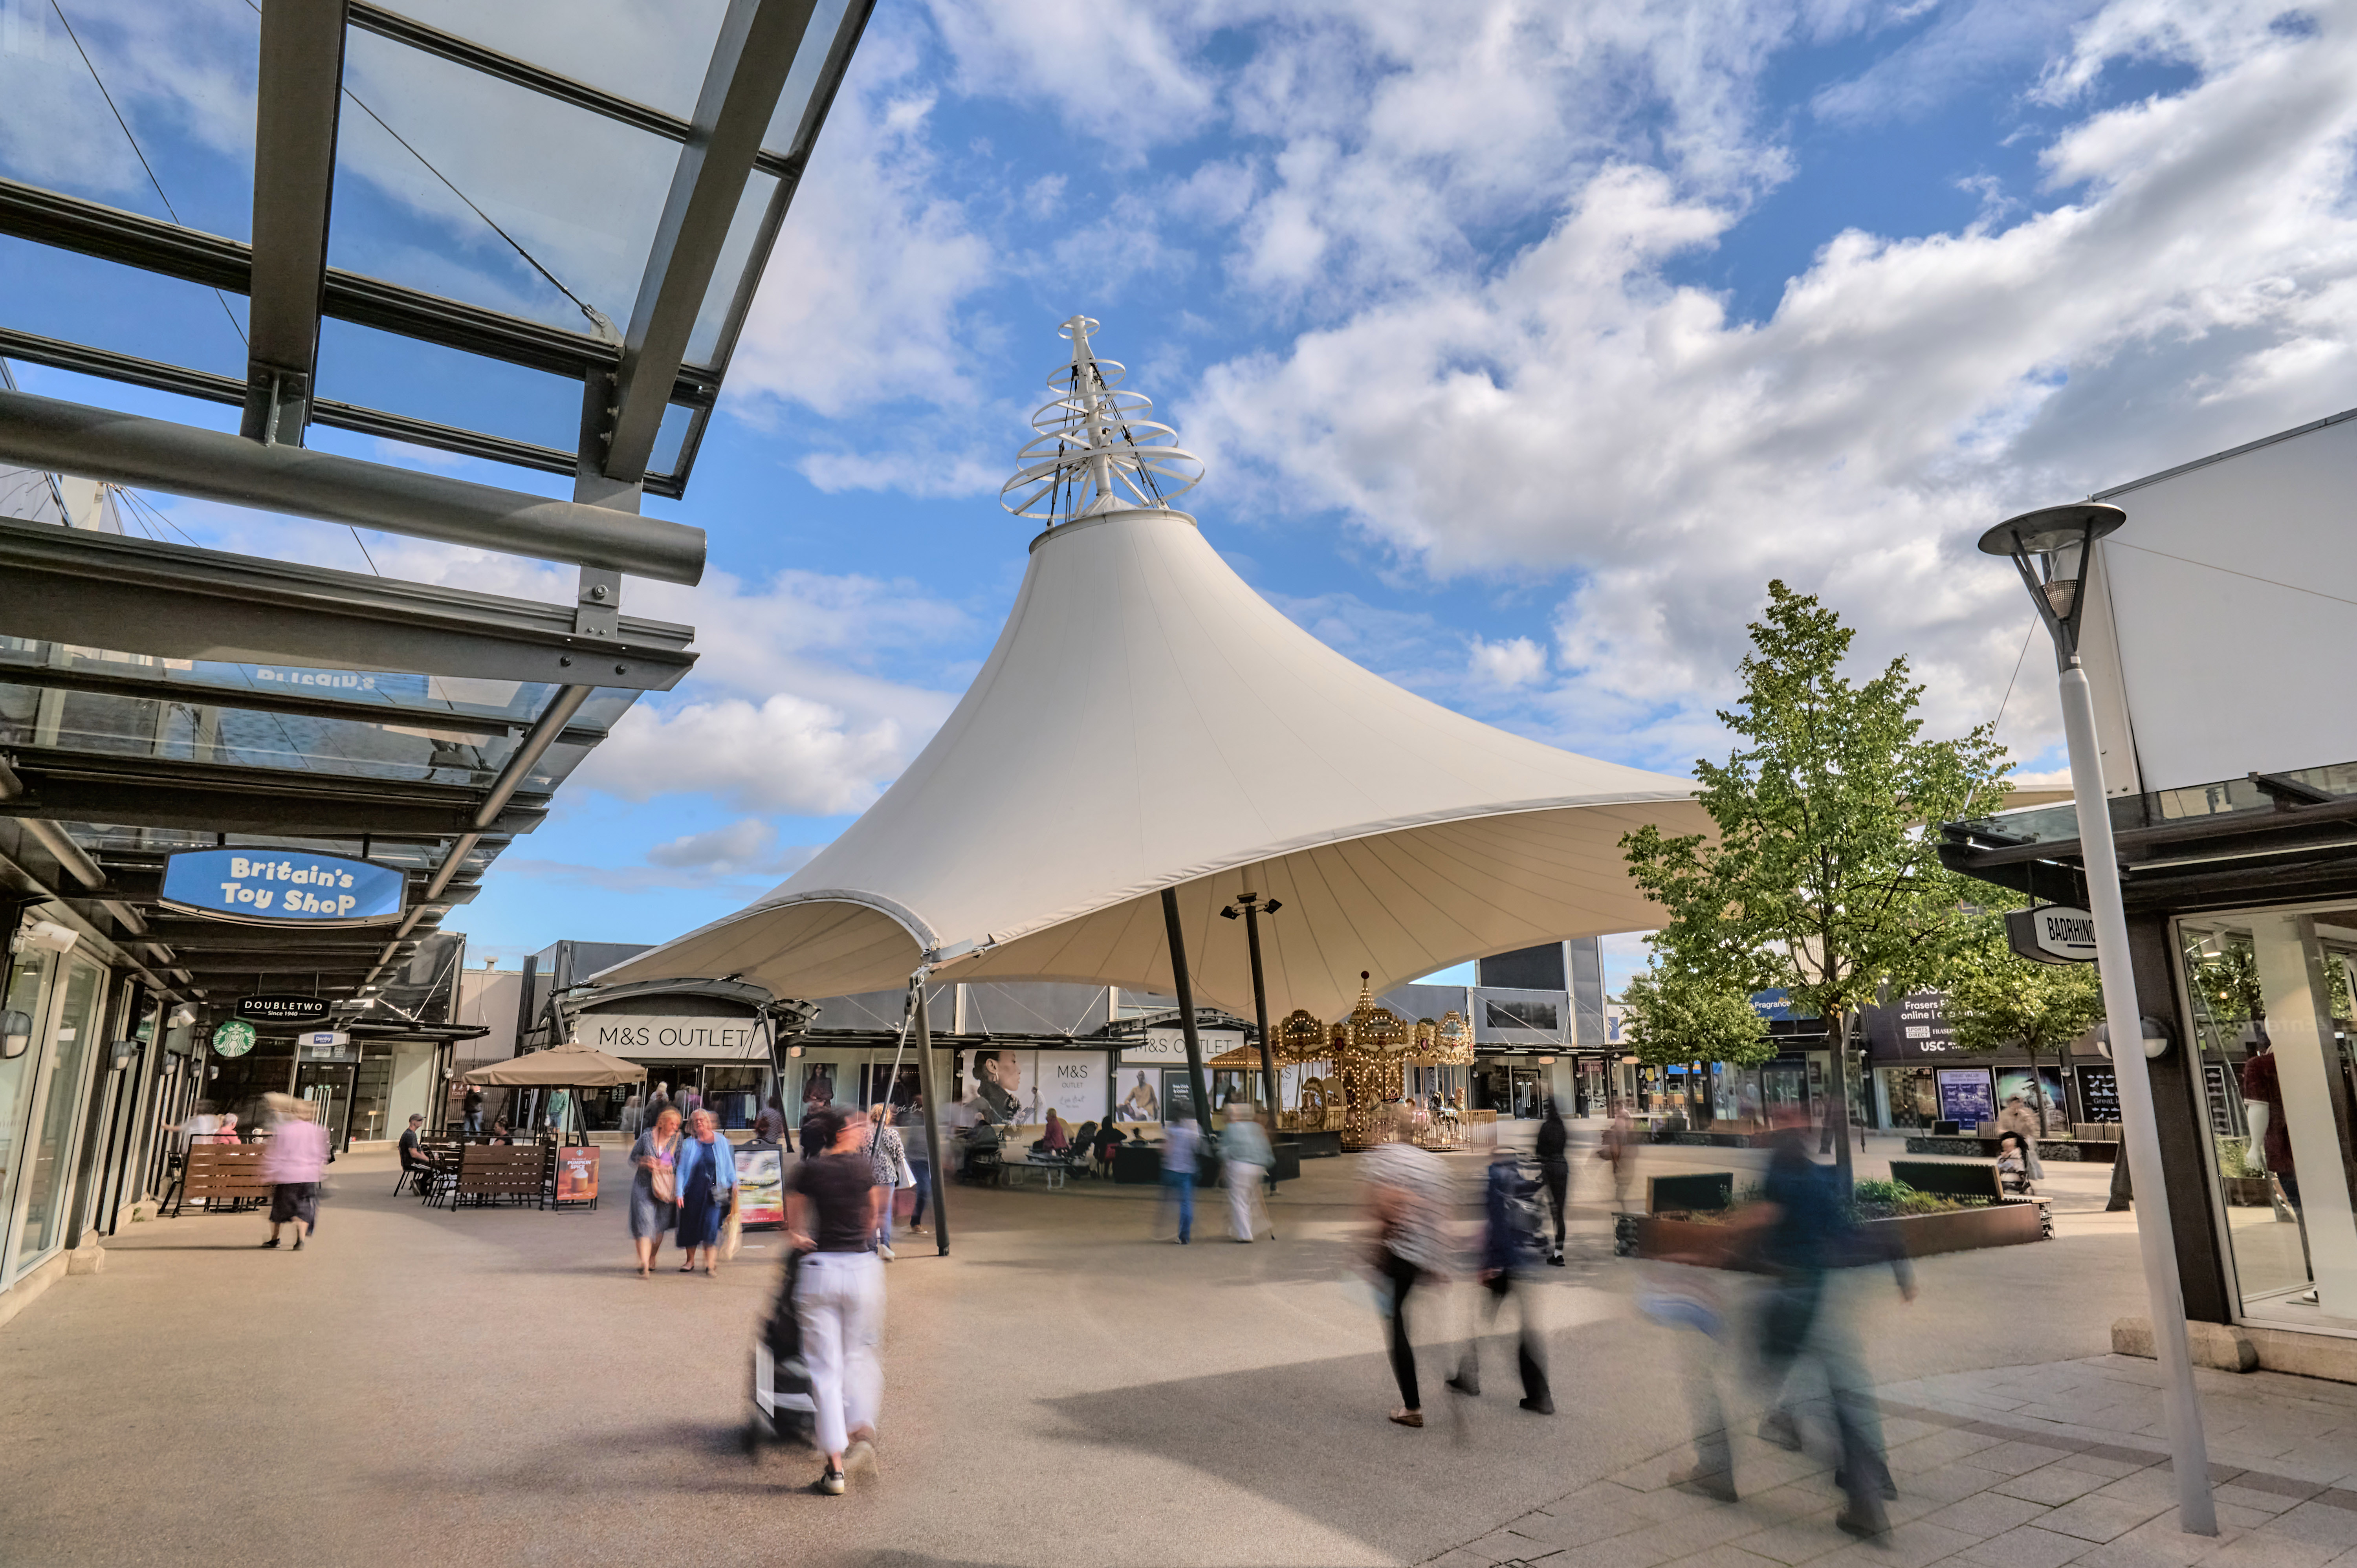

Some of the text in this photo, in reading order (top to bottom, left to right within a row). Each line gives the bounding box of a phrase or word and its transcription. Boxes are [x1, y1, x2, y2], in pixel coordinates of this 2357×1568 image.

[231, 857, 354, 888] Britain's
[221, 883, 356, 916] Toy Shop
[2047, 917, 2095, 942] BADRHINO
[244, 1001, 322, 1011] DOUBLETWO
[1905, 1001, 1938, 1010] Frasers
[1901, 1010, 1929, 1020] online
[599, 1027, 748, 1046] M&S OUTLET
[1174, 1039, 1232, 1053] OTLET
[1920, 1041, 1945, 1051] USC
[1058, 1065, 1088, 1078] M&S
